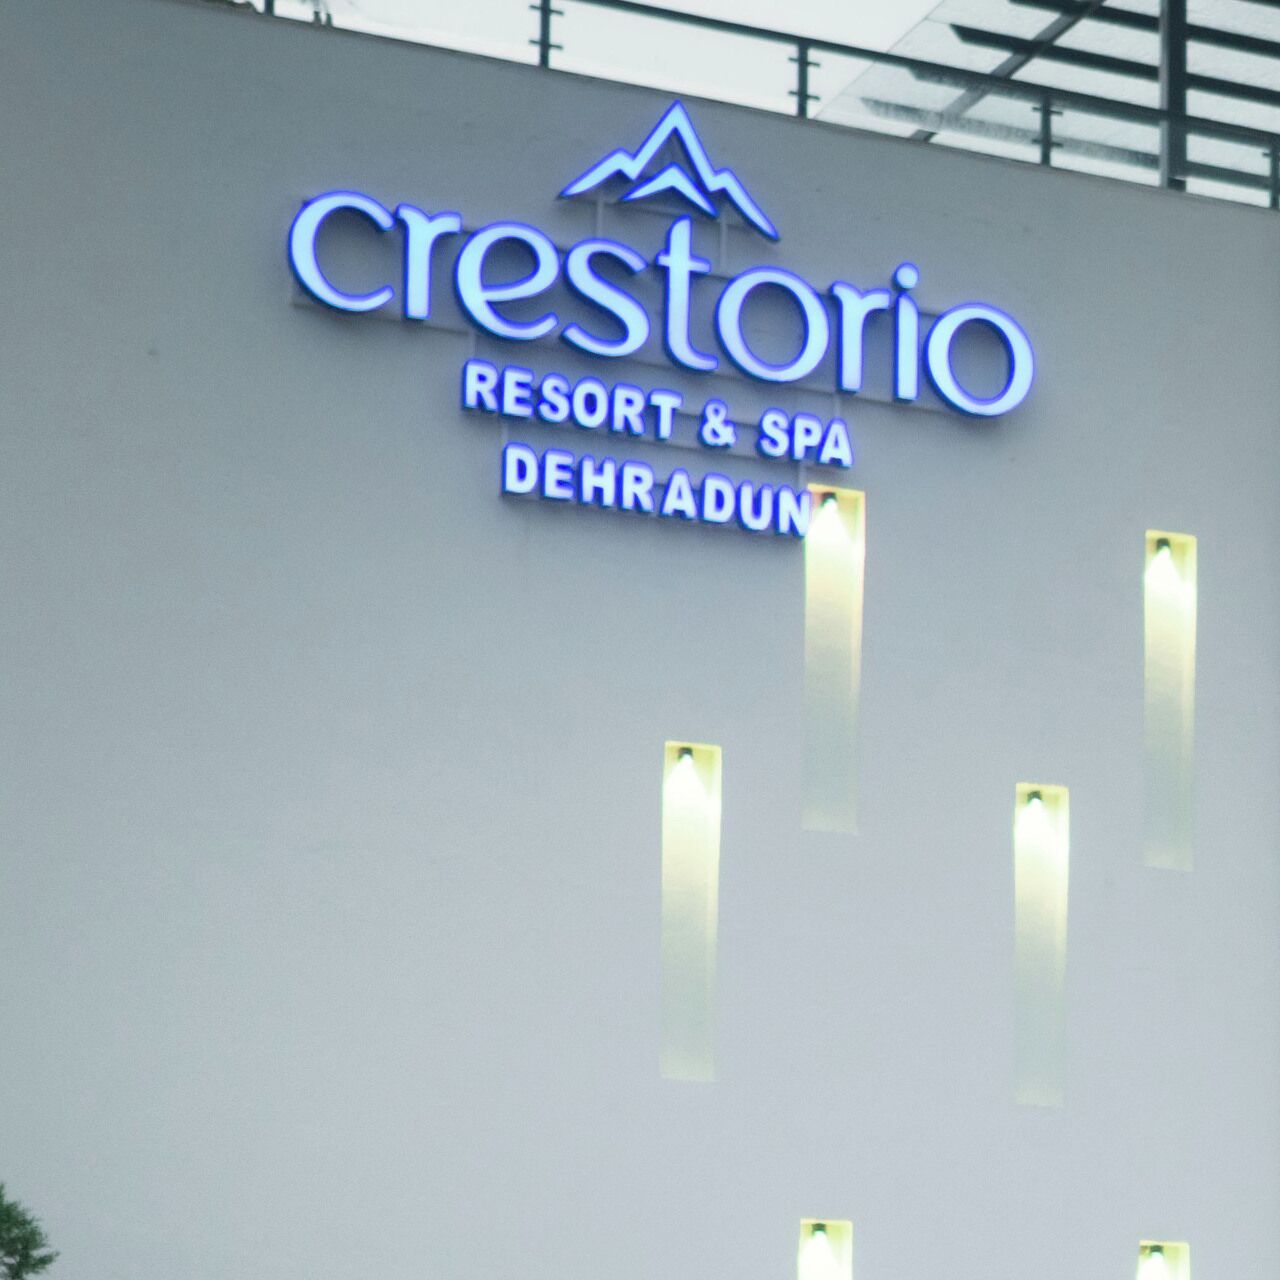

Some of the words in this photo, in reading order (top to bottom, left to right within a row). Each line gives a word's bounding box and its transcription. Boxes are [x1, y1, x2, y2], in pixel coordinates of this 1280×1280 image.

[288, 190, 1034, 417] crestorio
[463, 359, 682, 439] RESORT
[700, 399, 737, 448] &
[758, 407, 853, 468] SPA
[503, 442, 812, 537] DEHRADUN
